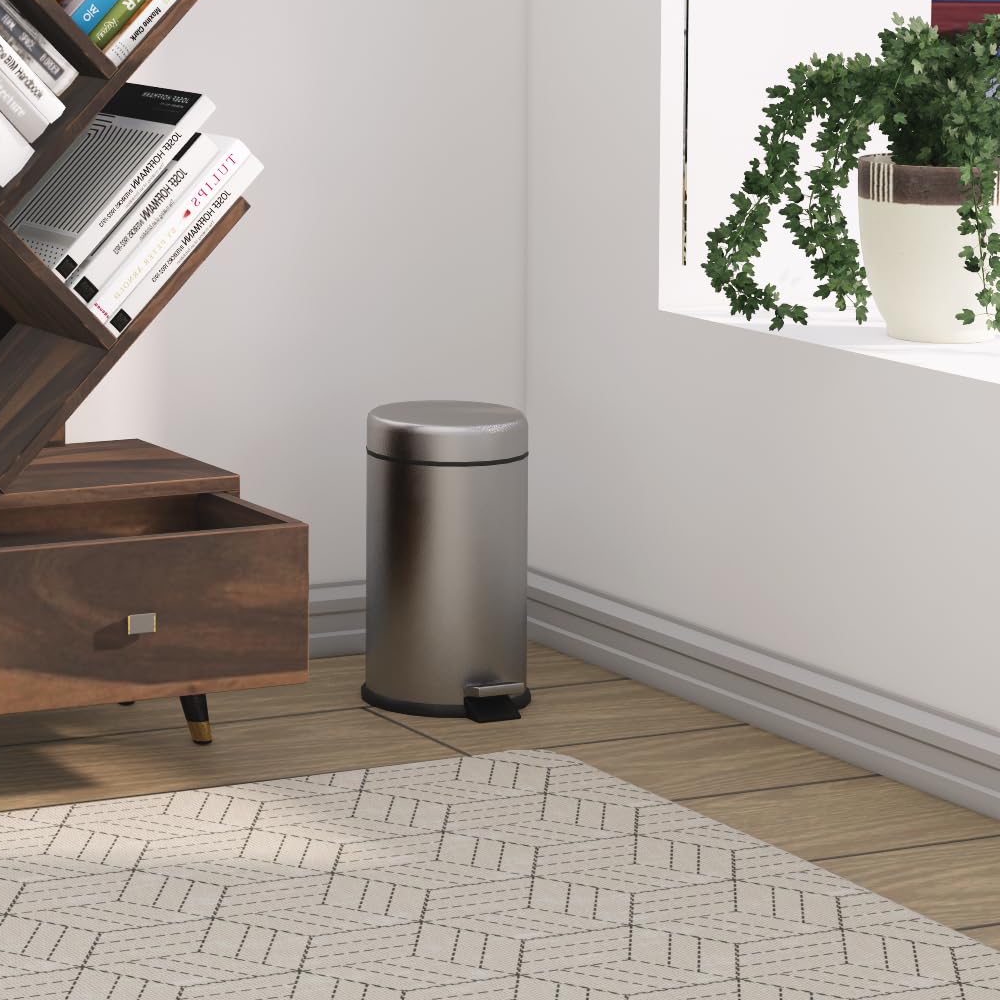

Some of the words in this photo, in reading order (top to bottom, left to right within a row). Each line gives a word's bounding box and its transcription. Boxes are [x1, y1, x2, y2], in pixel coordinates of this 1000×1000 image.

[143, 6, 162, 27] Maxine
[129, 25, 145, 42] Clark
[4, 52, 18, 70] BIM
